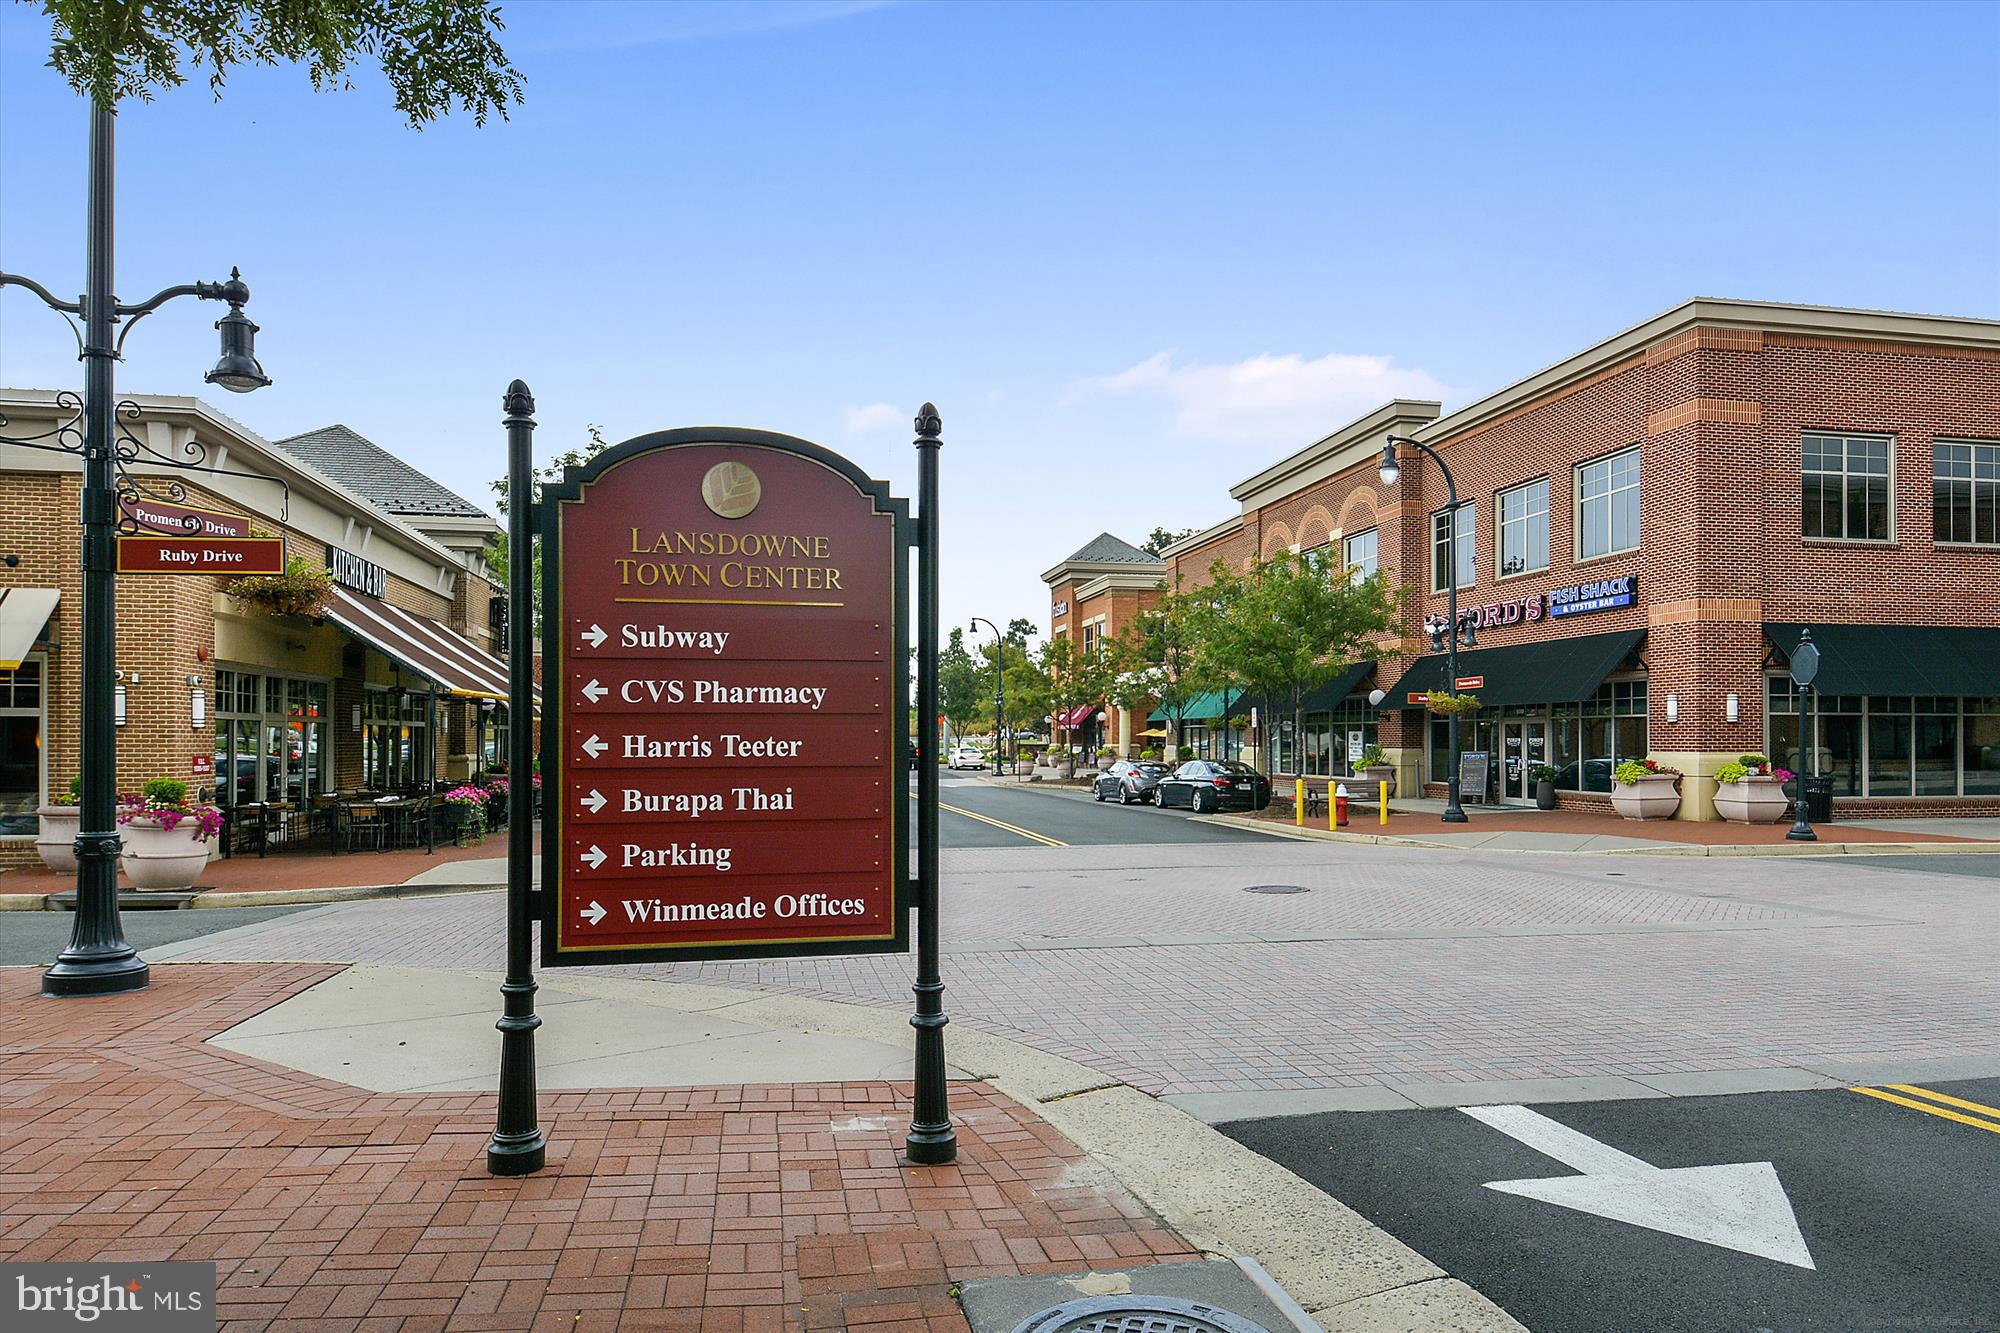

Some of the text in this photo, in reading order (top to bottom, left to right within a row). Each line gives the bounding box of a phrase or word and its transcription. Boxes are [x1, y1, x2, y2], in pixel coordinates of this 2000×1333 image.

[205, 520, 236, 536] Drive
[630, 527, 830, 559] LANSDOWNE
[160, 549, 243, 564] Ruby Drive
[332, 546, 387, 600] KITCHEN & BAR
[614, 559, 843, 590] TOWN CENTER
[1549, 577, 1630, 606] FISH SHACK
[1562, 597, 1615, 613] & OYSTER BAR
[621, 623, 730, 655] Subway
[620, 679, 827, 710] CVS Pharmacy
[621, 734, 802, 758] Harris Teeter
[621, 787, 794, 818] Burapa Thai
[621, 842, 732, 871] Parking
[621, 893, 865, 923] Winmeade Offices
